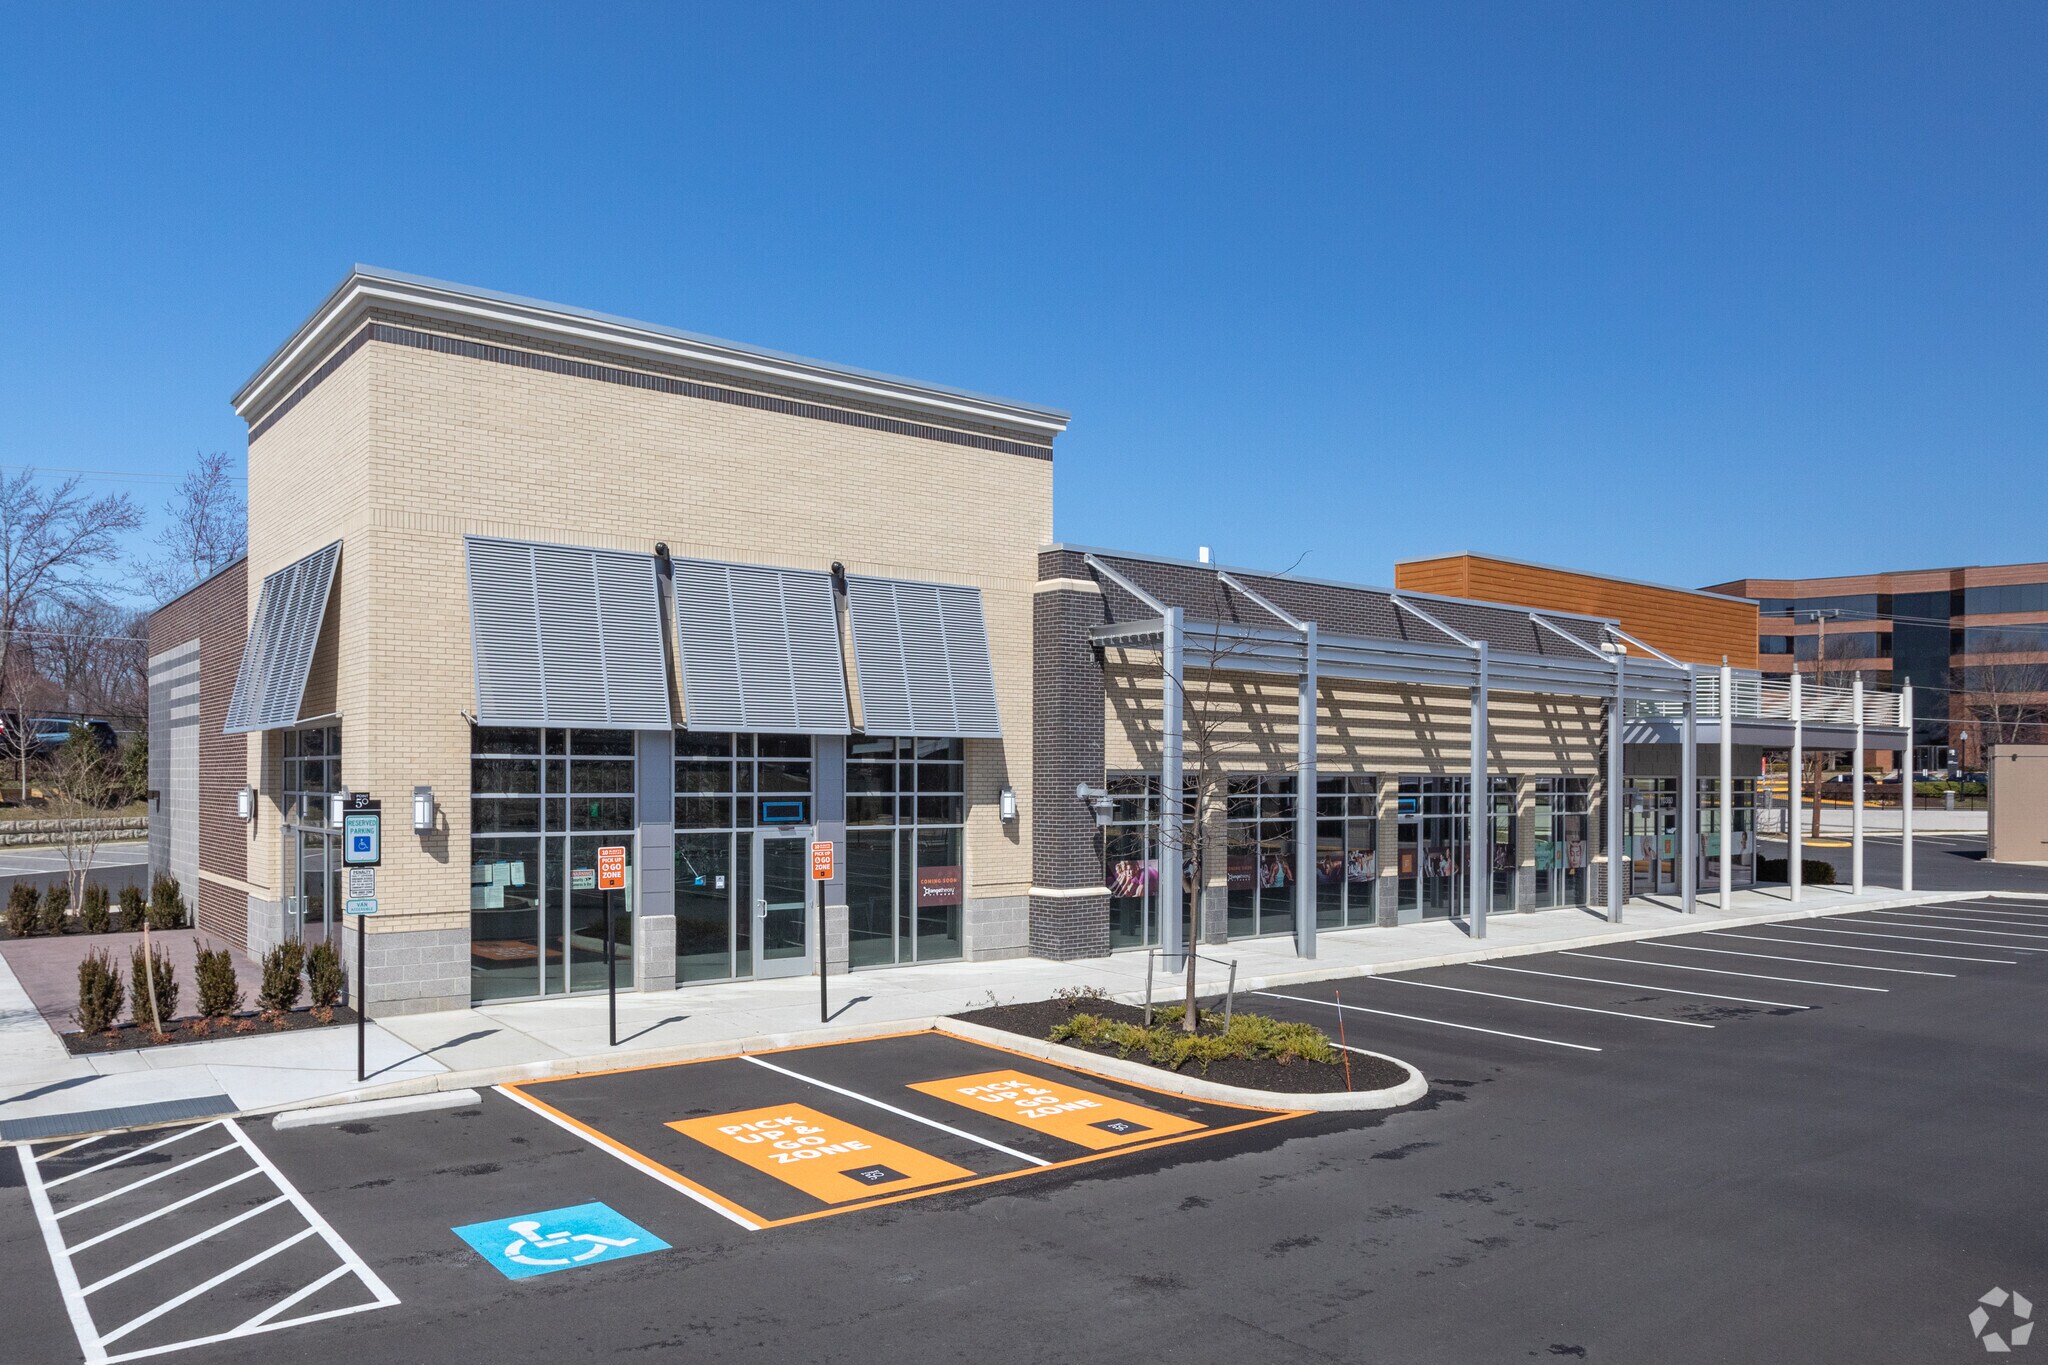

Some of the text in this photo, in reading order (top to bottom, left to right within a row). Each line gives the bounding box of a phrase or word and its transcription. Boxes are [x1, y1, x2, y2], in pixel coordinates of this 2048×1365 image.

[355, 798, 369, 808] 50
[956, 1080, 1031, 1096] PICK
[976, 1087, 1052, 1103] UP &
[1014, 1096, 1060, 1108] GO
[1017, 1099, 1104, 1119] ZONE
[717, 1116, 807, 1136] PICK
[733, 1125, 825, 1144] UP &
[773, 1136, 827, 1150] GO
[768, 1140, 872, 1164] ZONE
